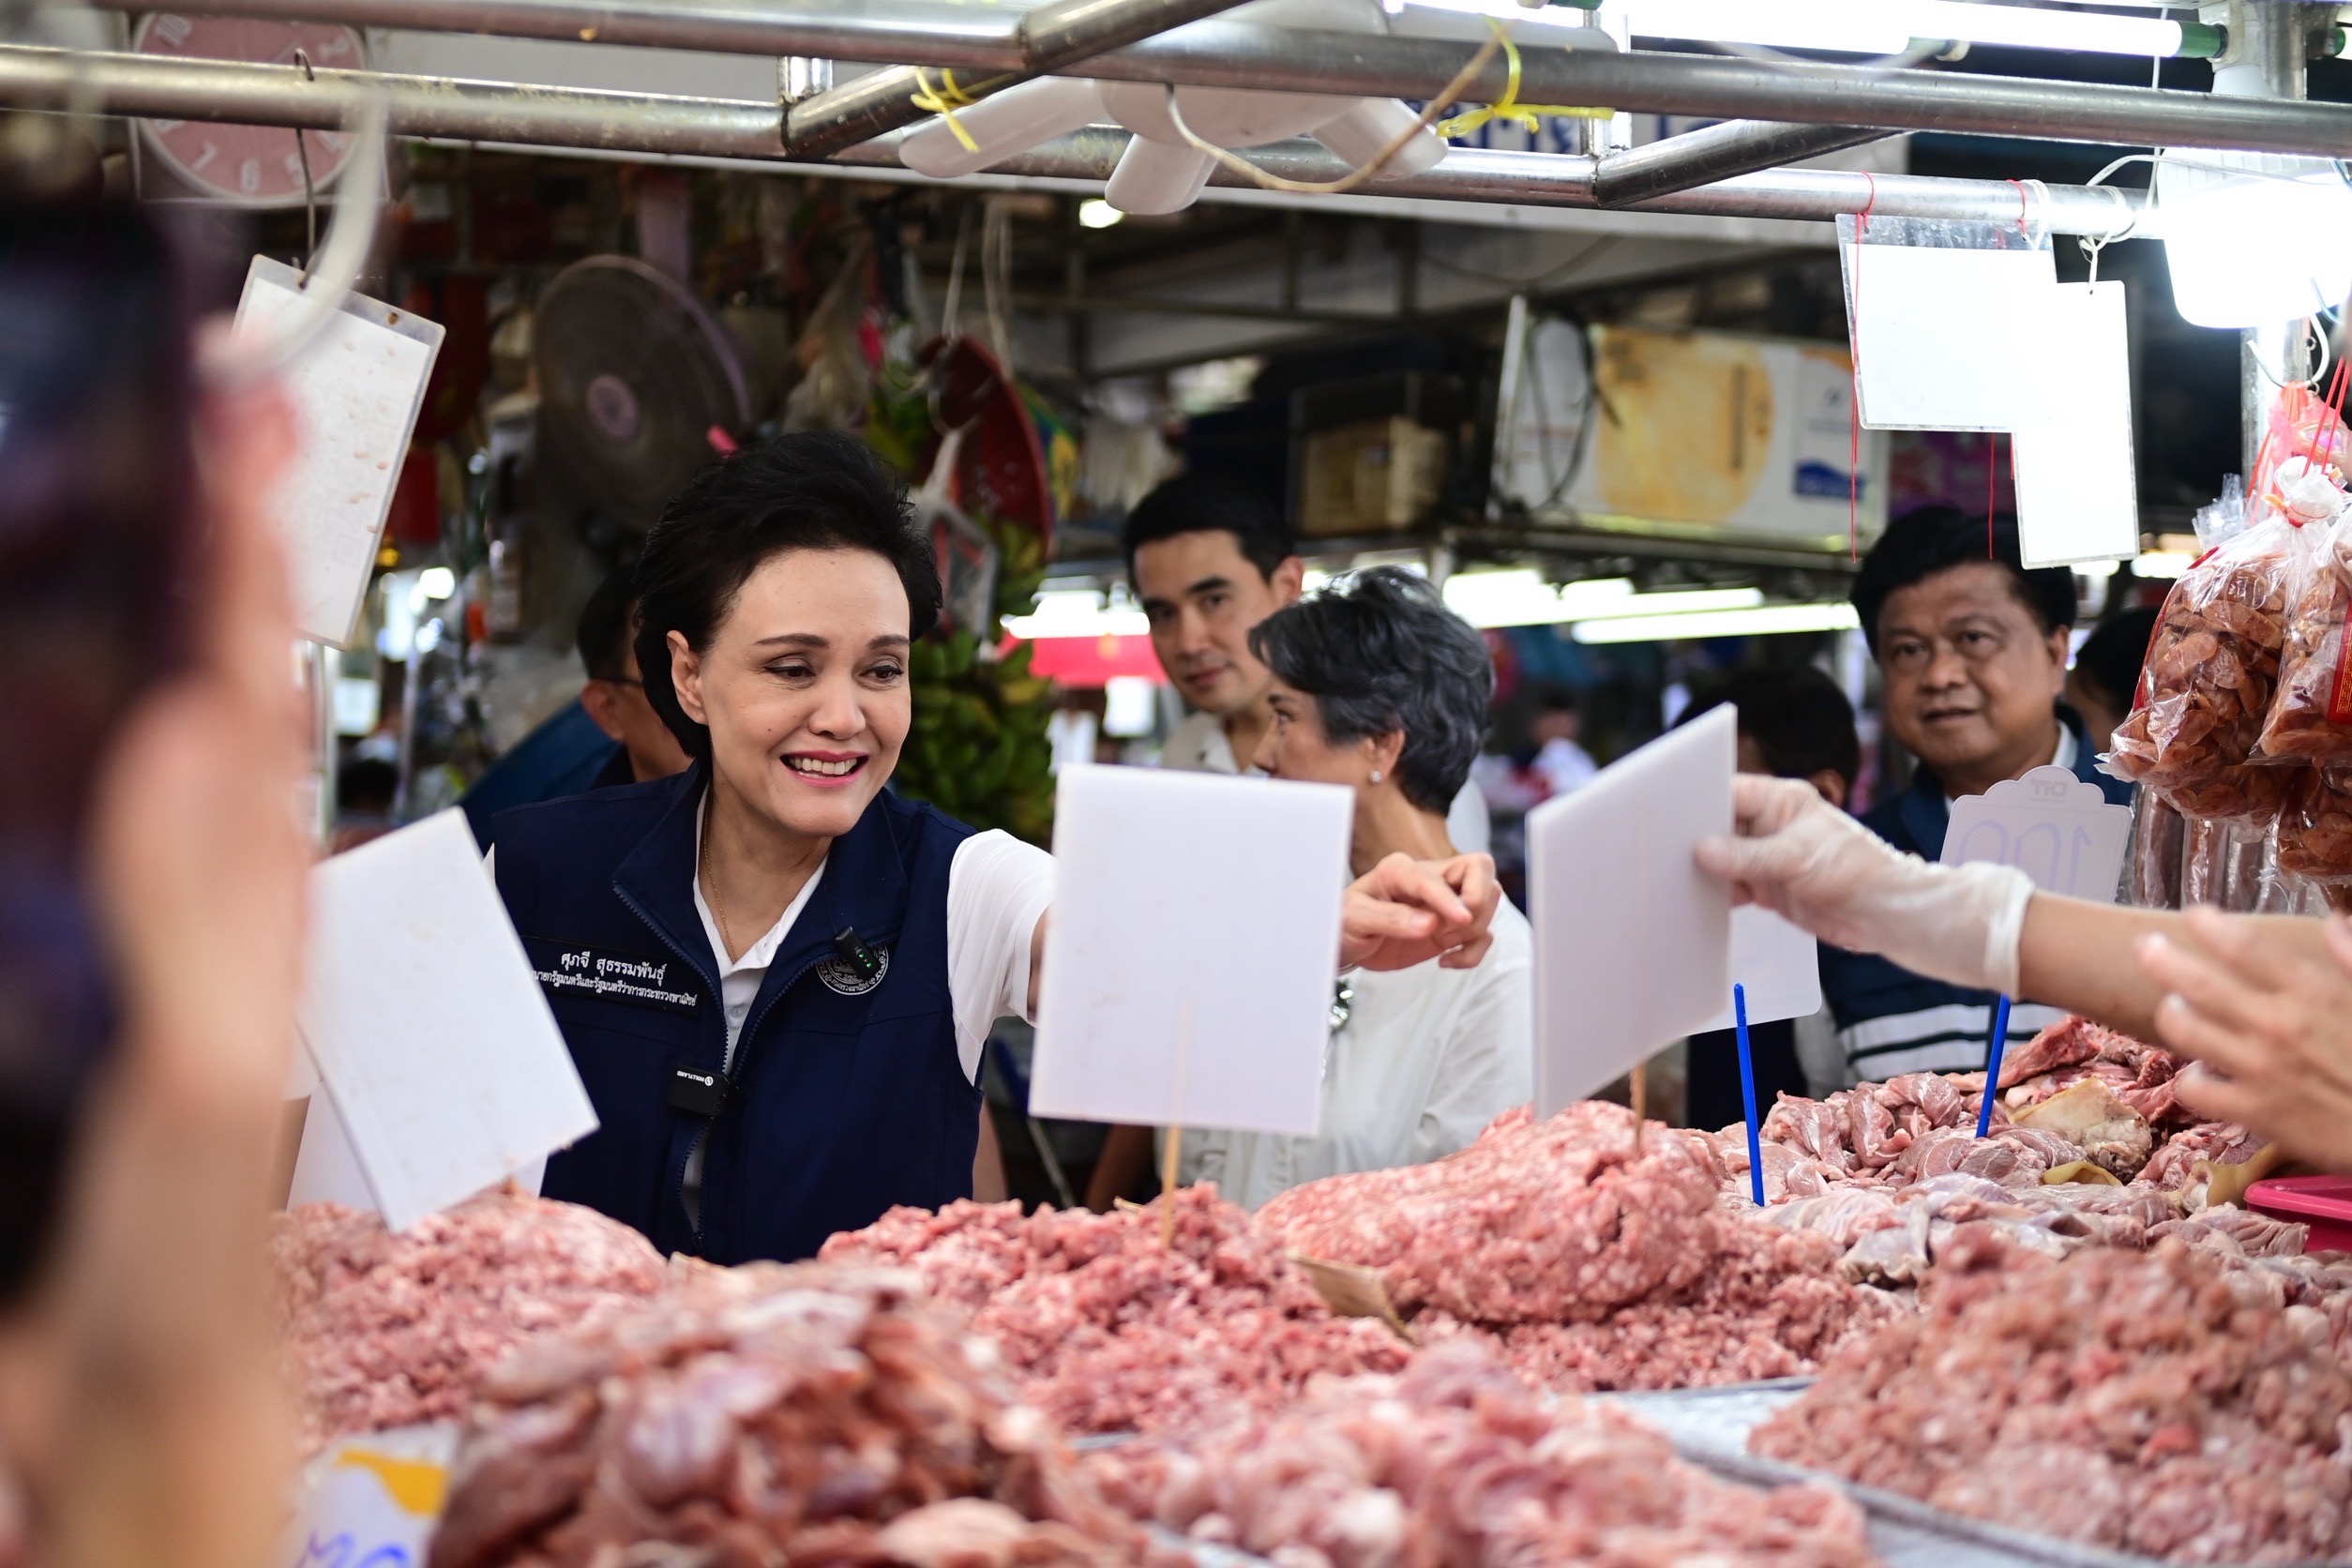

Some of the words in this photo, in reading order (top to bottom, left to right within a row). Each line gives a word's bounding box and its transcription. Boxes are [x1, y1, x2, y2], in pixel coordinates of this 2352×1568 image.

[191, 141, 219, 172] 7
[240, 158, 262, 193] 6
[561, 950, 591, 972] ศุภจี
[596, 957, 668, 988] สุธรรมพันธุ์
[676, 1070, 705, 1083] HOLLYLAND
